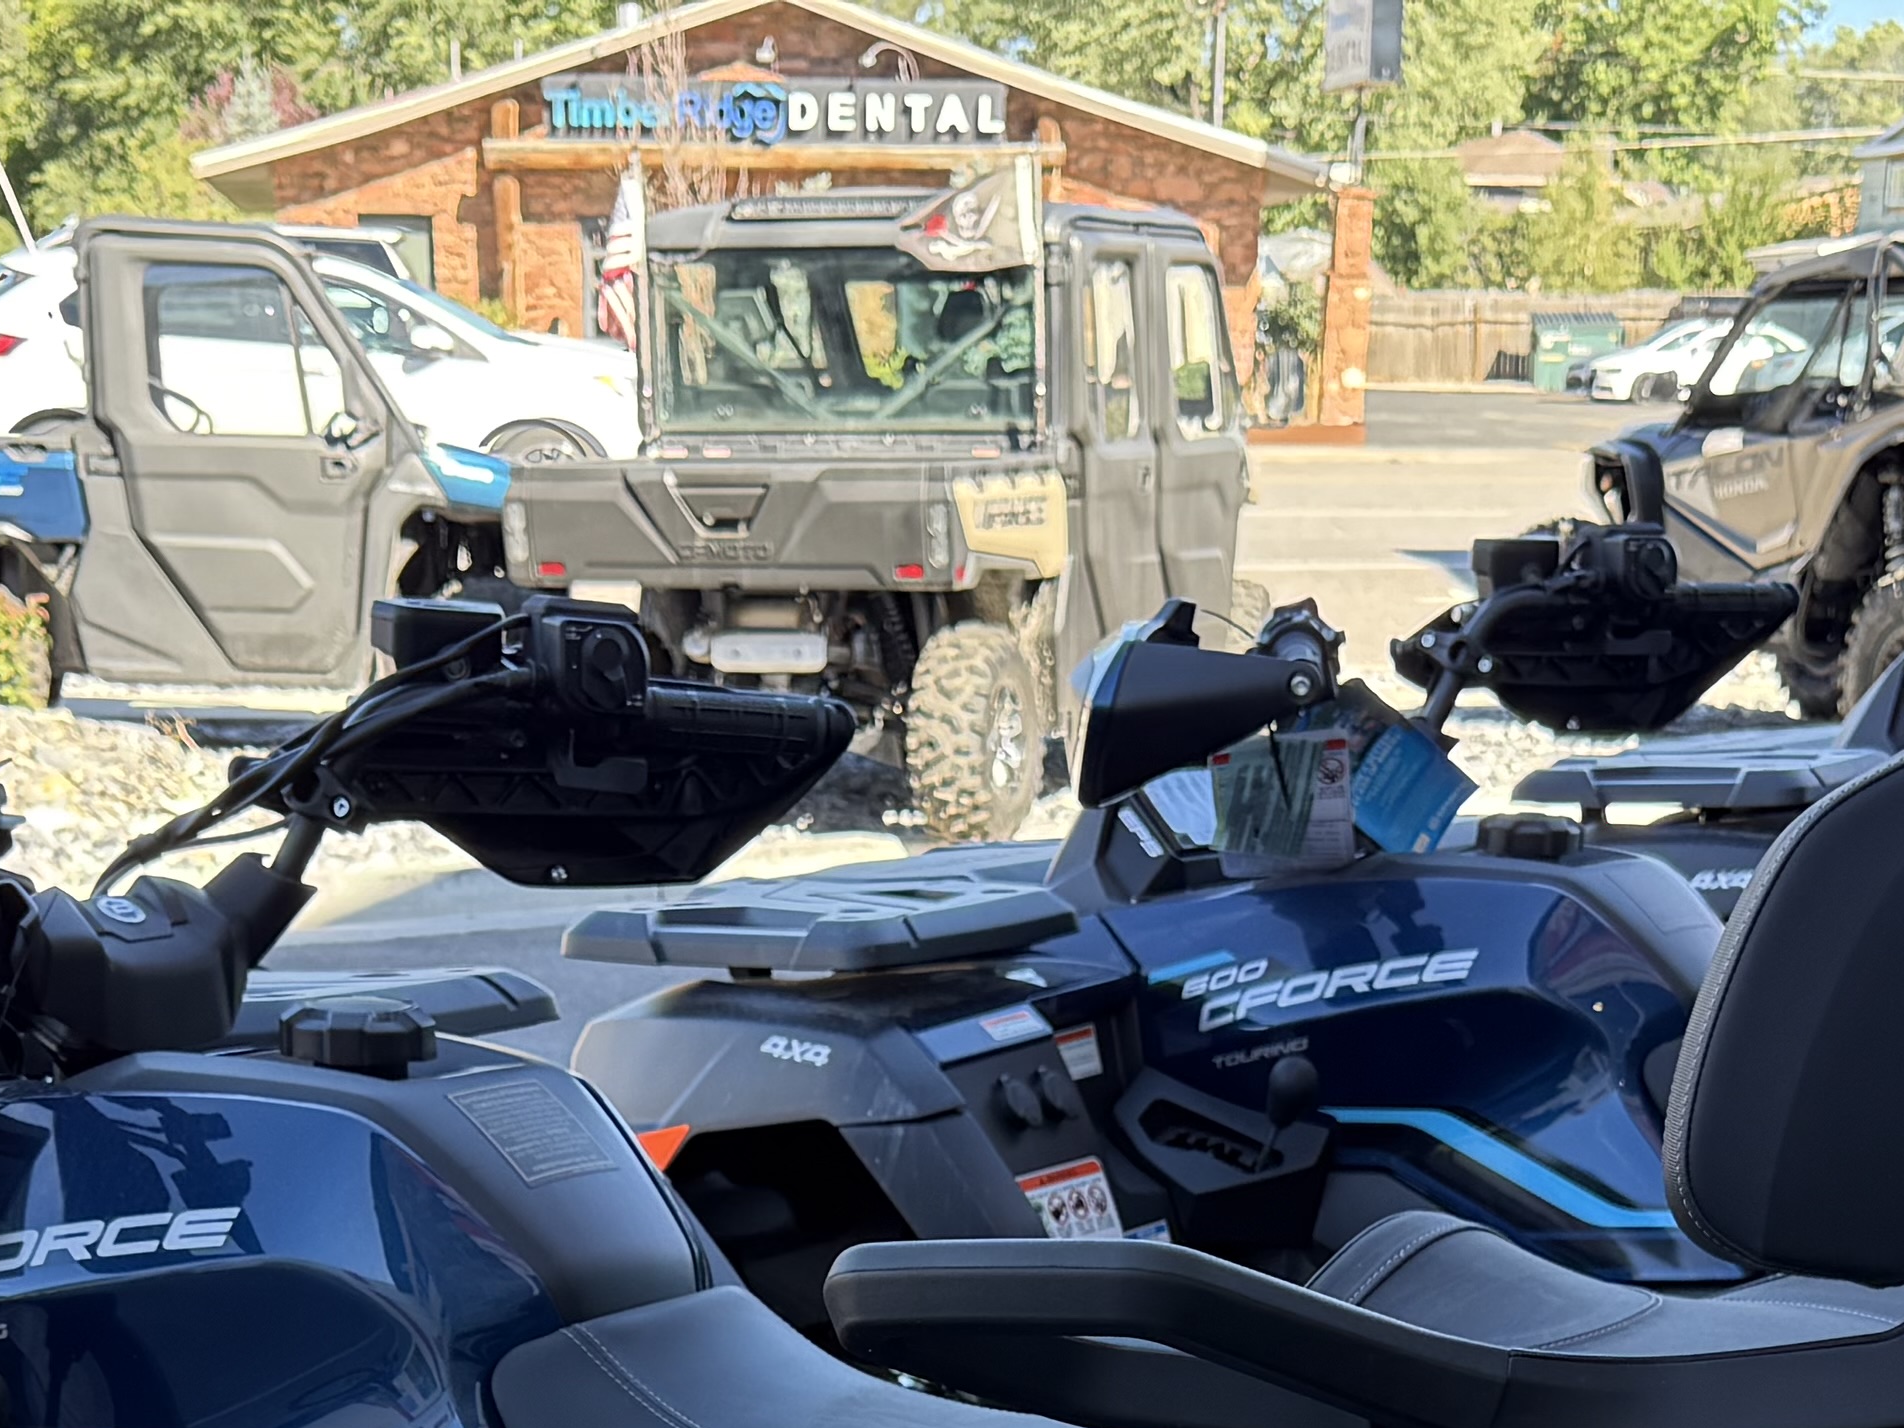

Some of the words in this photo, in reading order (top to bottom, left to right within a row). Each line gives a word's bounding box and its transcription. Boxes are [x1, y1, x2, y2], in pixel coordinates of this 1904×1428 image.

[544, 86, 671, 129] Timbe
[787, 91, 1006, 135] DENTAL
[1181, 957, 1269, 1000] 600
[1198, 948, 1480, 1033] CFORCE
[1211, 1036, 1310, 1070] TOURING
